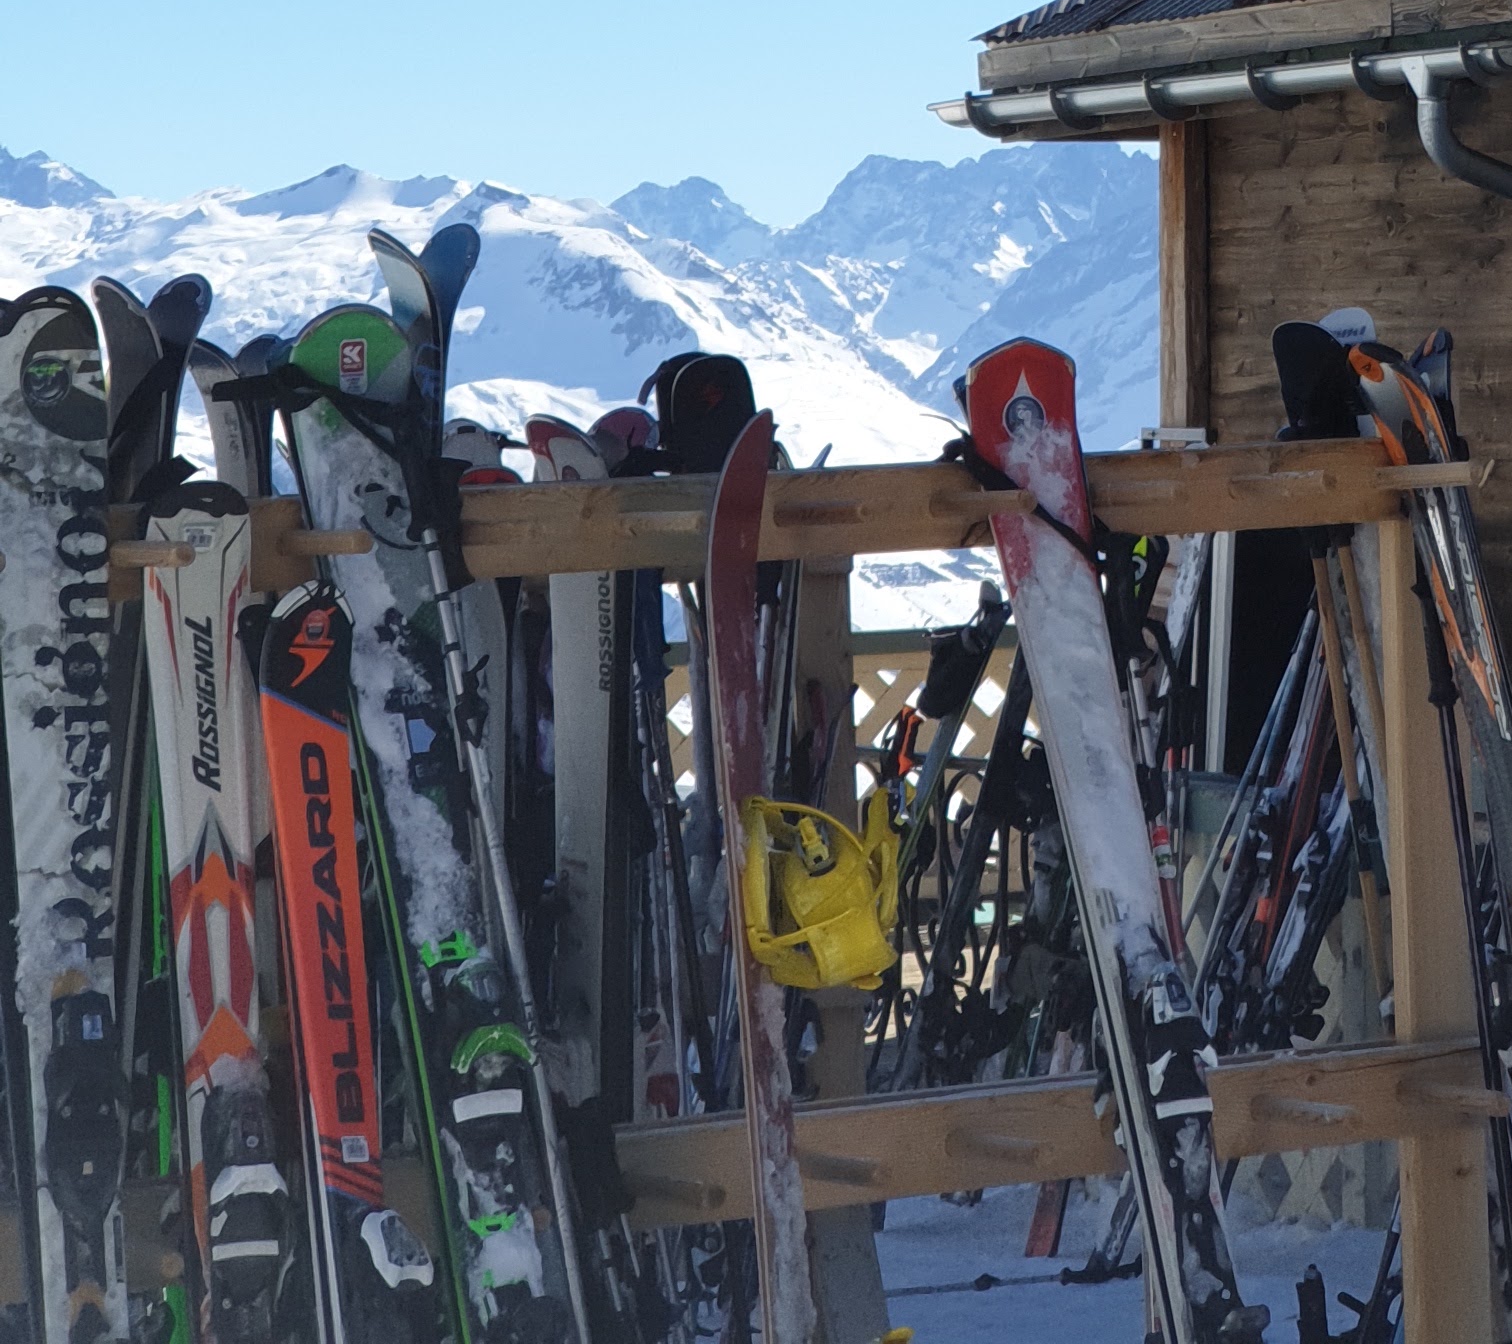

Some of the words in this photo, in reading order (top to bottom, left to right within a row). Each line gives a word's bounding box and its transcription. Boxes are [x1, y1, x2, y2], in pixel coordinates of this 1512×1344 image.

[192, 616, 222, 792] ROSSIGNOL
[597, 571, 614, 692] ROSSIGNOL
[301, 741, 367, 1124] BLIZZARD
